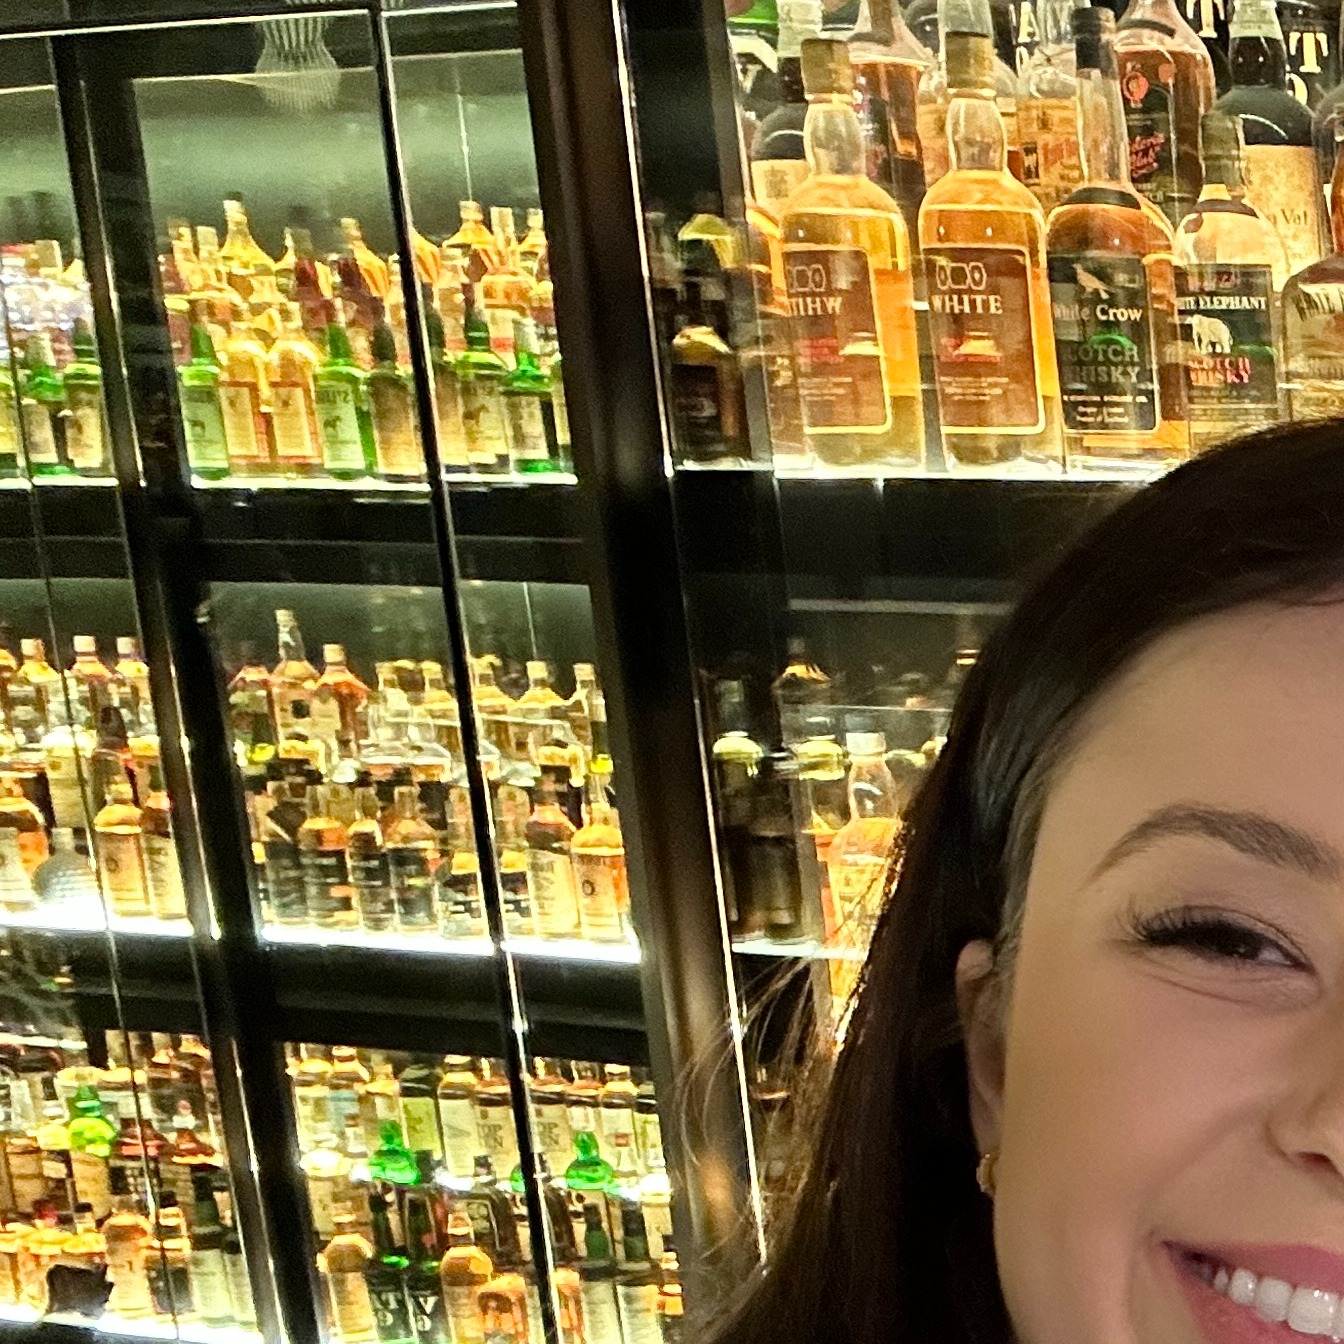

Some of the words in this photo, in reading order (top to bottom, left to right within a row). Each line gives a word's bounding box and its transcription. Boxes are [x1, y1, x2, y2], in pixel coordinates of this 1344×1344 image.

[931, 294, 1004, 315] WHITE
[1199, 296, 1267, 310] ELEPHANT
[1096, 304, 1143, 322] Crow
